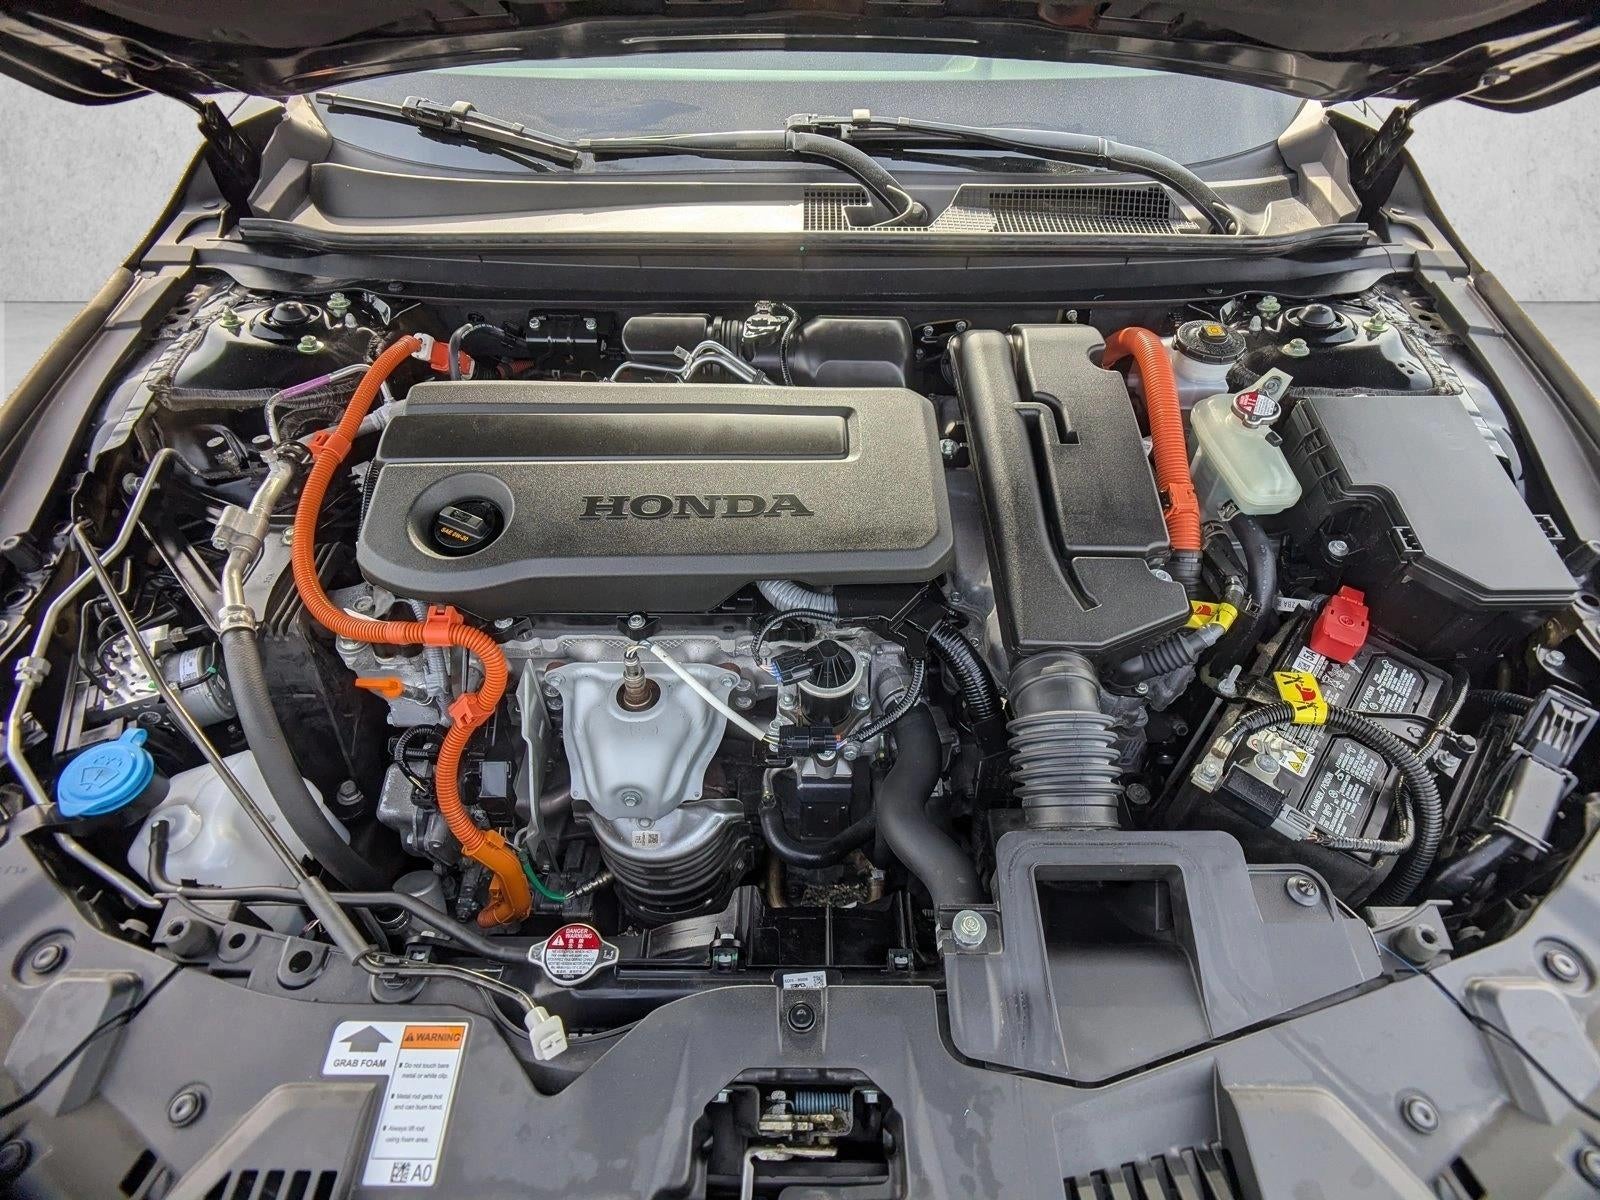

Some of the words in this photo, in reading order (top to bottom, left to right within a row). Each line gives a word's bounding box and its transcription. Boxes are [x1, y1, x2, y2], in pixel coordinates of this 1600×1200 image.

[579, 493, 814, 520] HONDA
[441, 527, 453, 536] SAE
[416, 1033, 461, 1042] WARNING
[333, 1060, 358, 1068] GRAB
[360, 1060, 387, 1068] FOAM
[410, 1163, 433, 1182] A0
